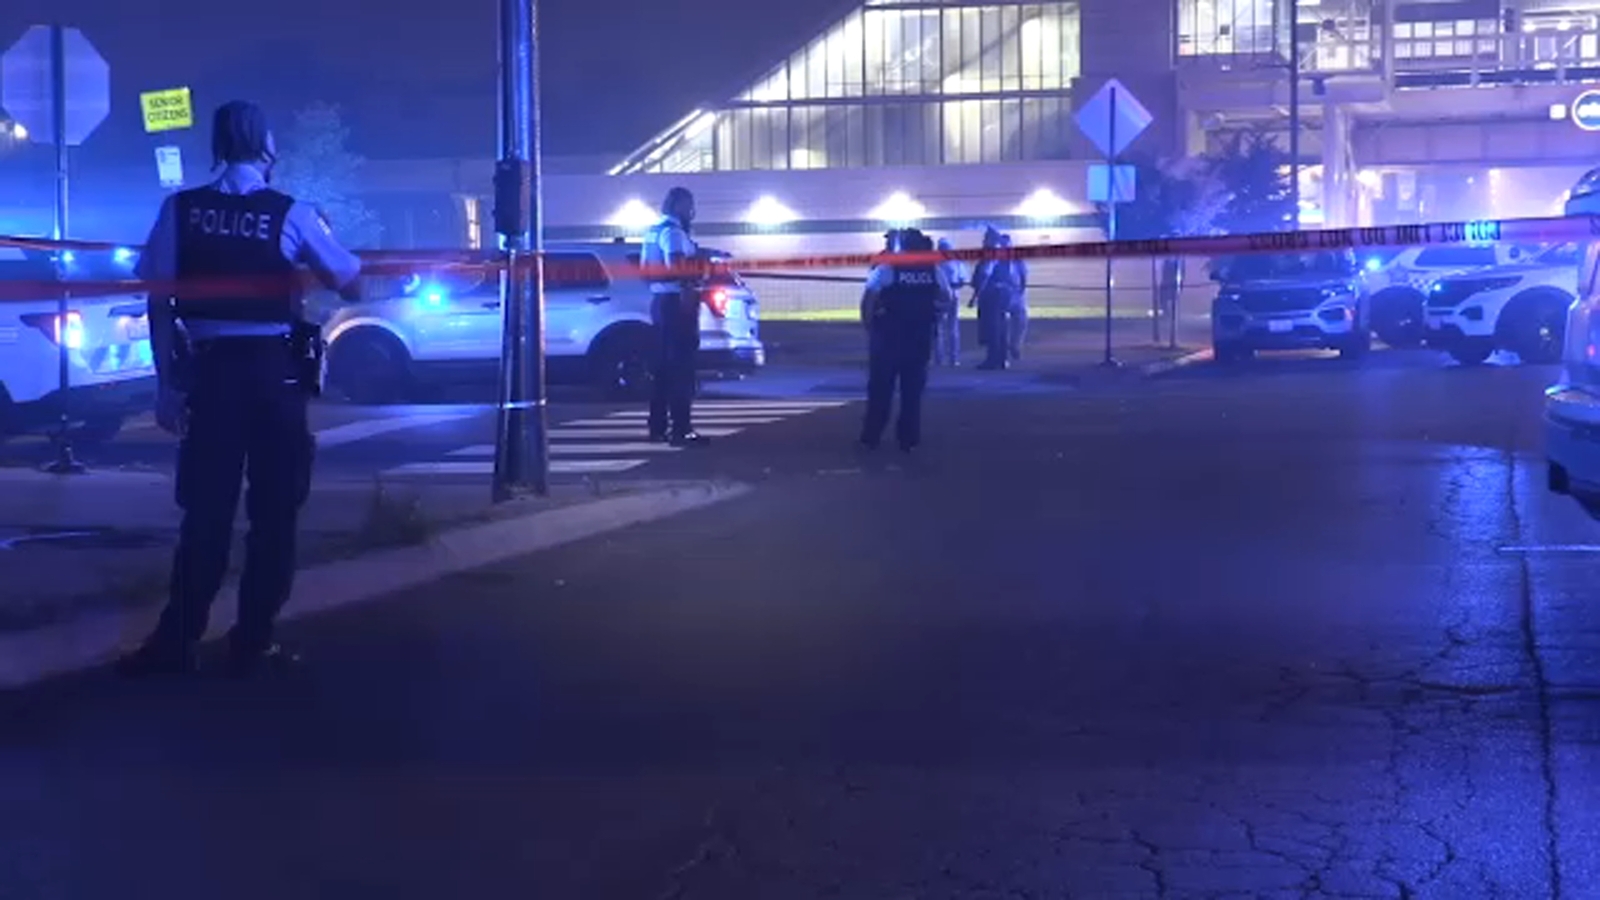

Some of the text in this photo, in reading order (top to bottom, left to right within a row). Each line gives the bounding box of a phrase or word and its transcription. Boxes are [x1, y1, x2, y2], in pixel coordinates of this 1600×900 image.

[149, 96, 183, 109] SENIOR
[148, 107, 188, 123] CITIZENS
[189, 206, 270, 239] POLICE
